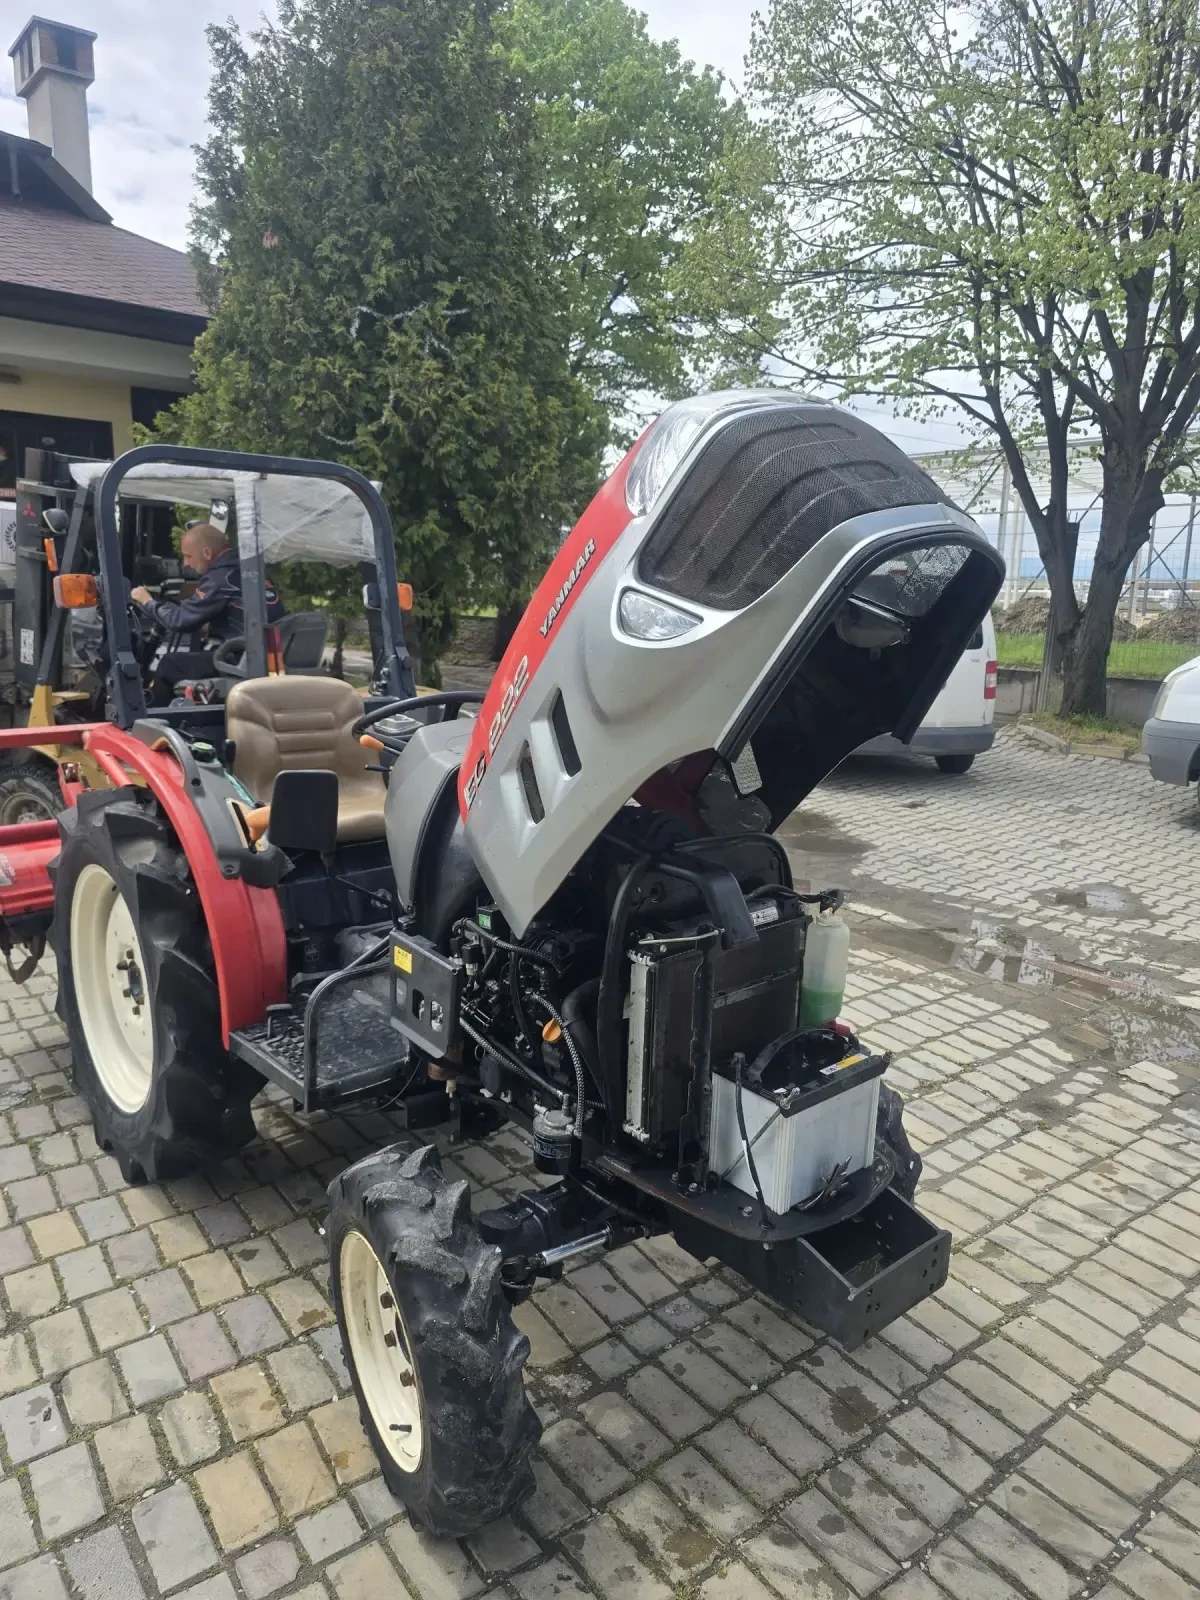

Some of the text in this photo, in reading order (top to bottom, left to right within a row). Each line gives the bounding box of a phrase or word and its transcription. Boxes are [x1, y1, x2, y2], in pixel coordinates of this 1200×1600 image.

[539, 538, 596, 638] YANMAR
[463, 655, 529, 811] EG 222
